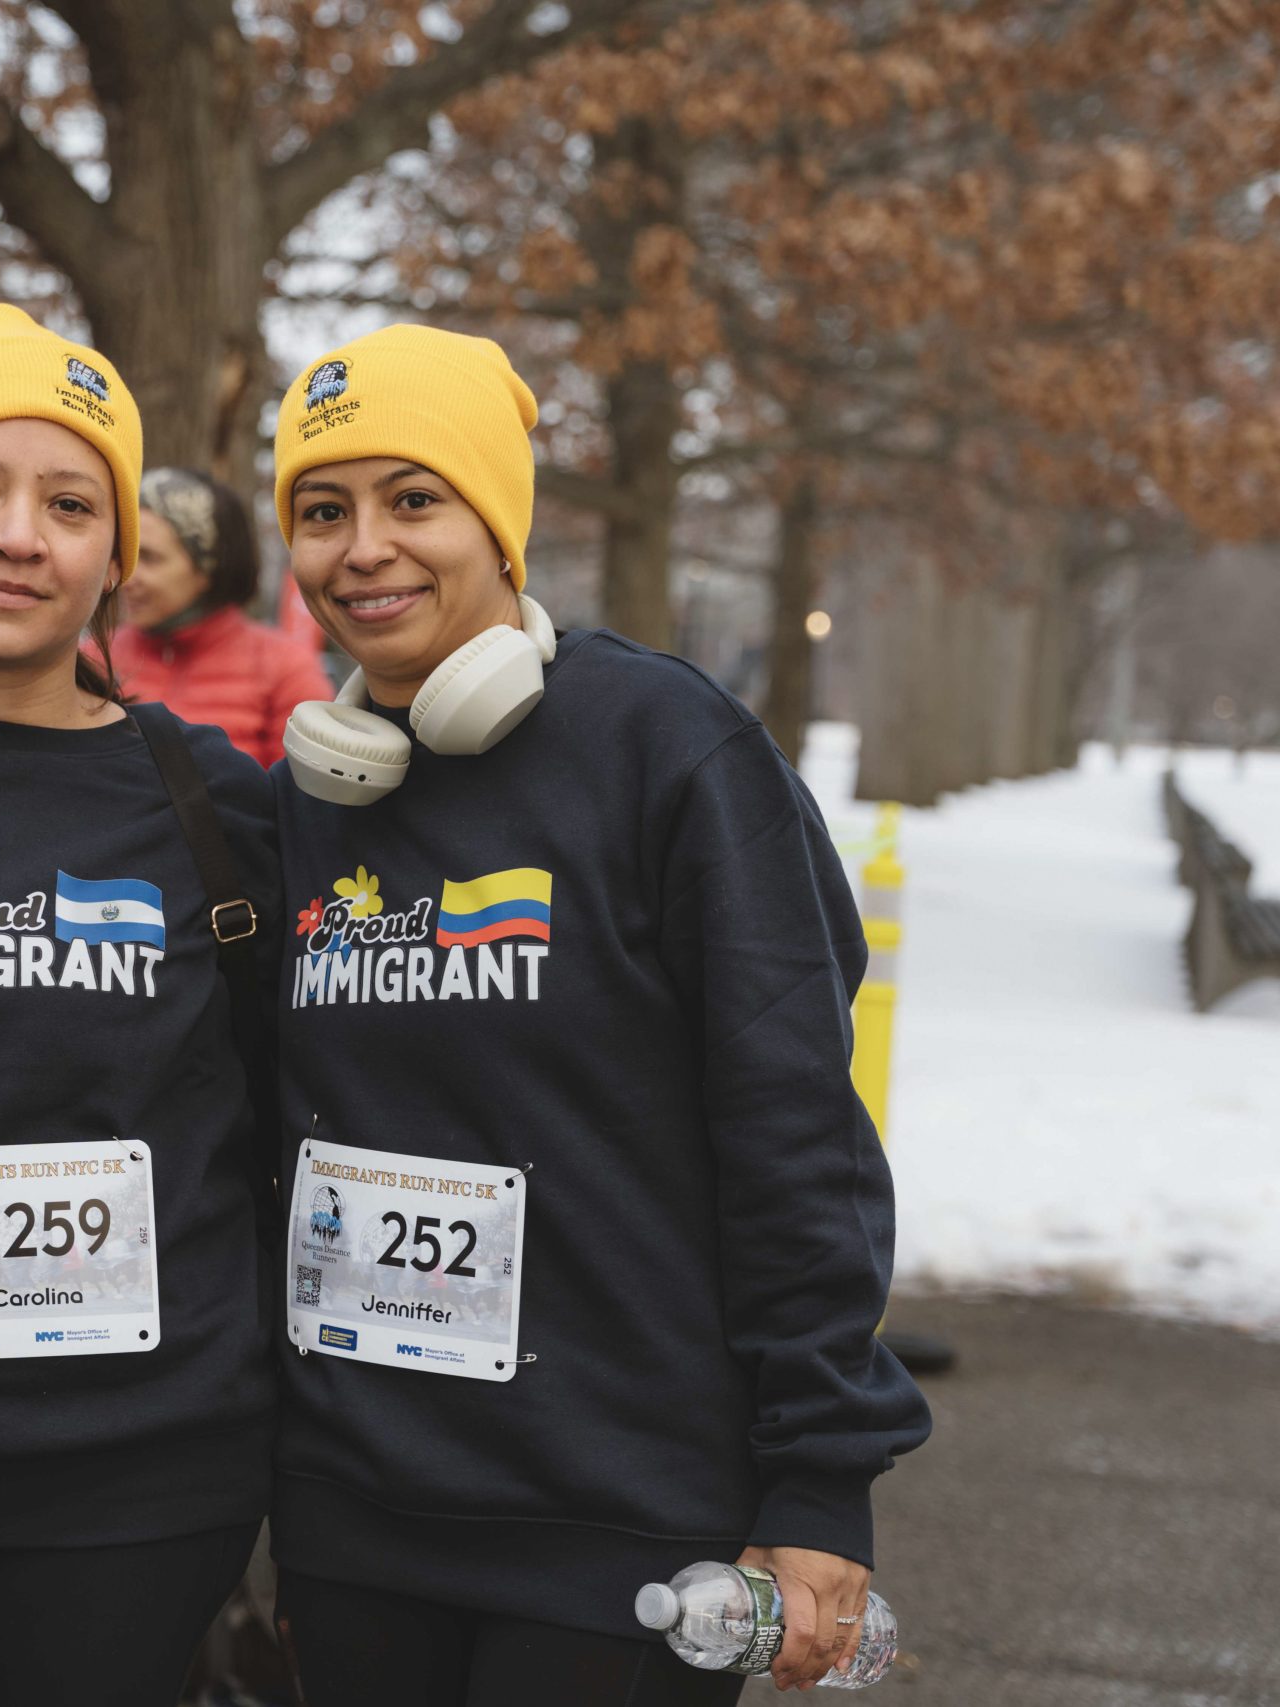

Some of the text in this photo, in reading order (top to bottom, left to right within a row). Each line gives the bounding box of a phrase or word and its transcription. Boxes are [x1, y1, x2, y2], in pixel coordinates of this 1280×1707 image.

[56, 387, 115, 426] Immigrants
[62, 398, 110, 432] Run NYC
[298, 401, 360, 432] Immigrants
[303, 412, 355, 441] Run NYC
[307, 896, 432, 954] Proud
[292, 943, 549, 1009] IMMIGRANT
[21, 1162, 60, 1178] RUN
[63, 1160, 99, 1177] NYC
[102, 1159, 126, 1174] 5K
[311, 1160, 497, 1200] IMMIGRANTS RUN NYC 5K
[3, 1199, 111, 1258] 259
[139, 1227, 148, 1245] 259
[376, 1211, 477, 1277] 252
[302, 1240, 351, 1257] Queens Distance
[312, 1251, 337, 1263] Runners
[503, 1257, 512, 1275] 252
[361, 1295, 451, 1324] Jenniffer
[35, 1331, 64, 1342] NYC
[397, 1343, 422, 1357] NYC
[740, 1626, 768, 1668] Poland
[753, 1625, 781, 1668] Spring
